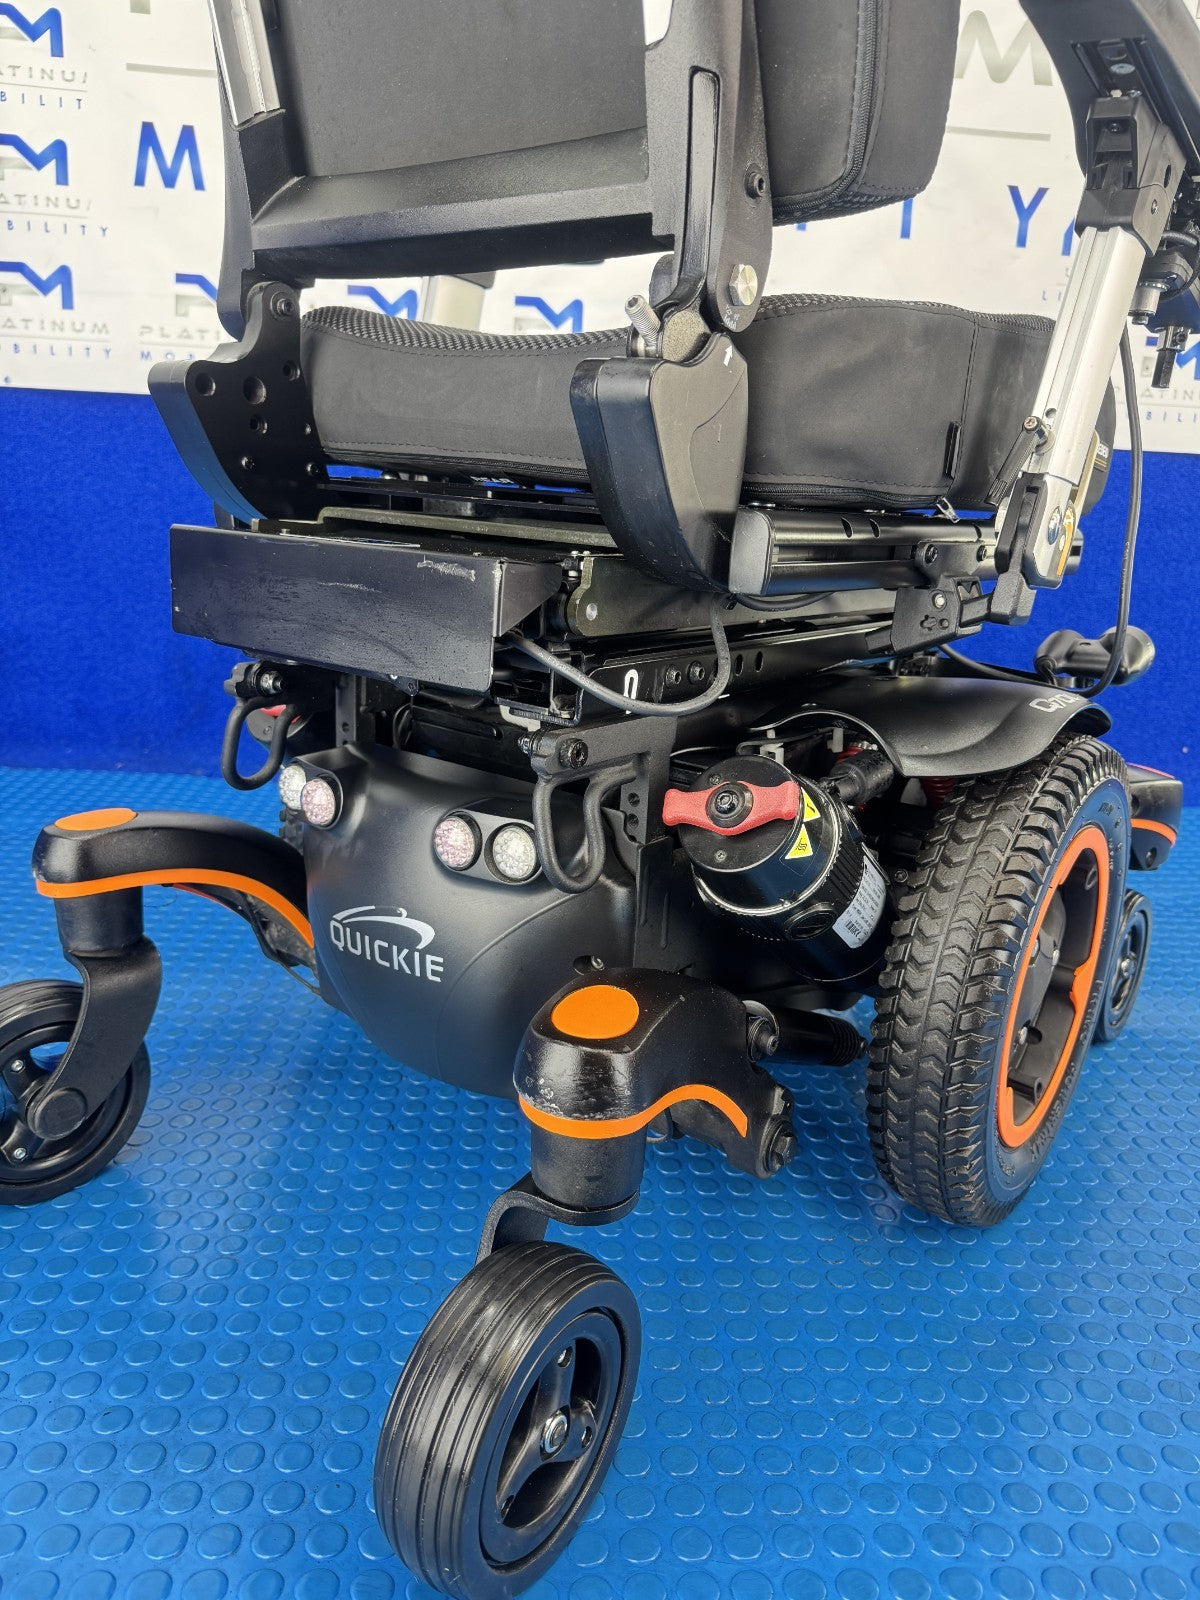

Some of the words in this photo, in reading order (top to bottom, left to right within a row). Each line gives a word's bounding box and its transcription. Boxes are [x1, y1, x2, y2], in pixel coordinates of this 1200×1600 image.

[0, 65, 88, 84] TINU
[140, 325, 220, 341] PLATI
[329, 919, 444, 983] QUICKIE
